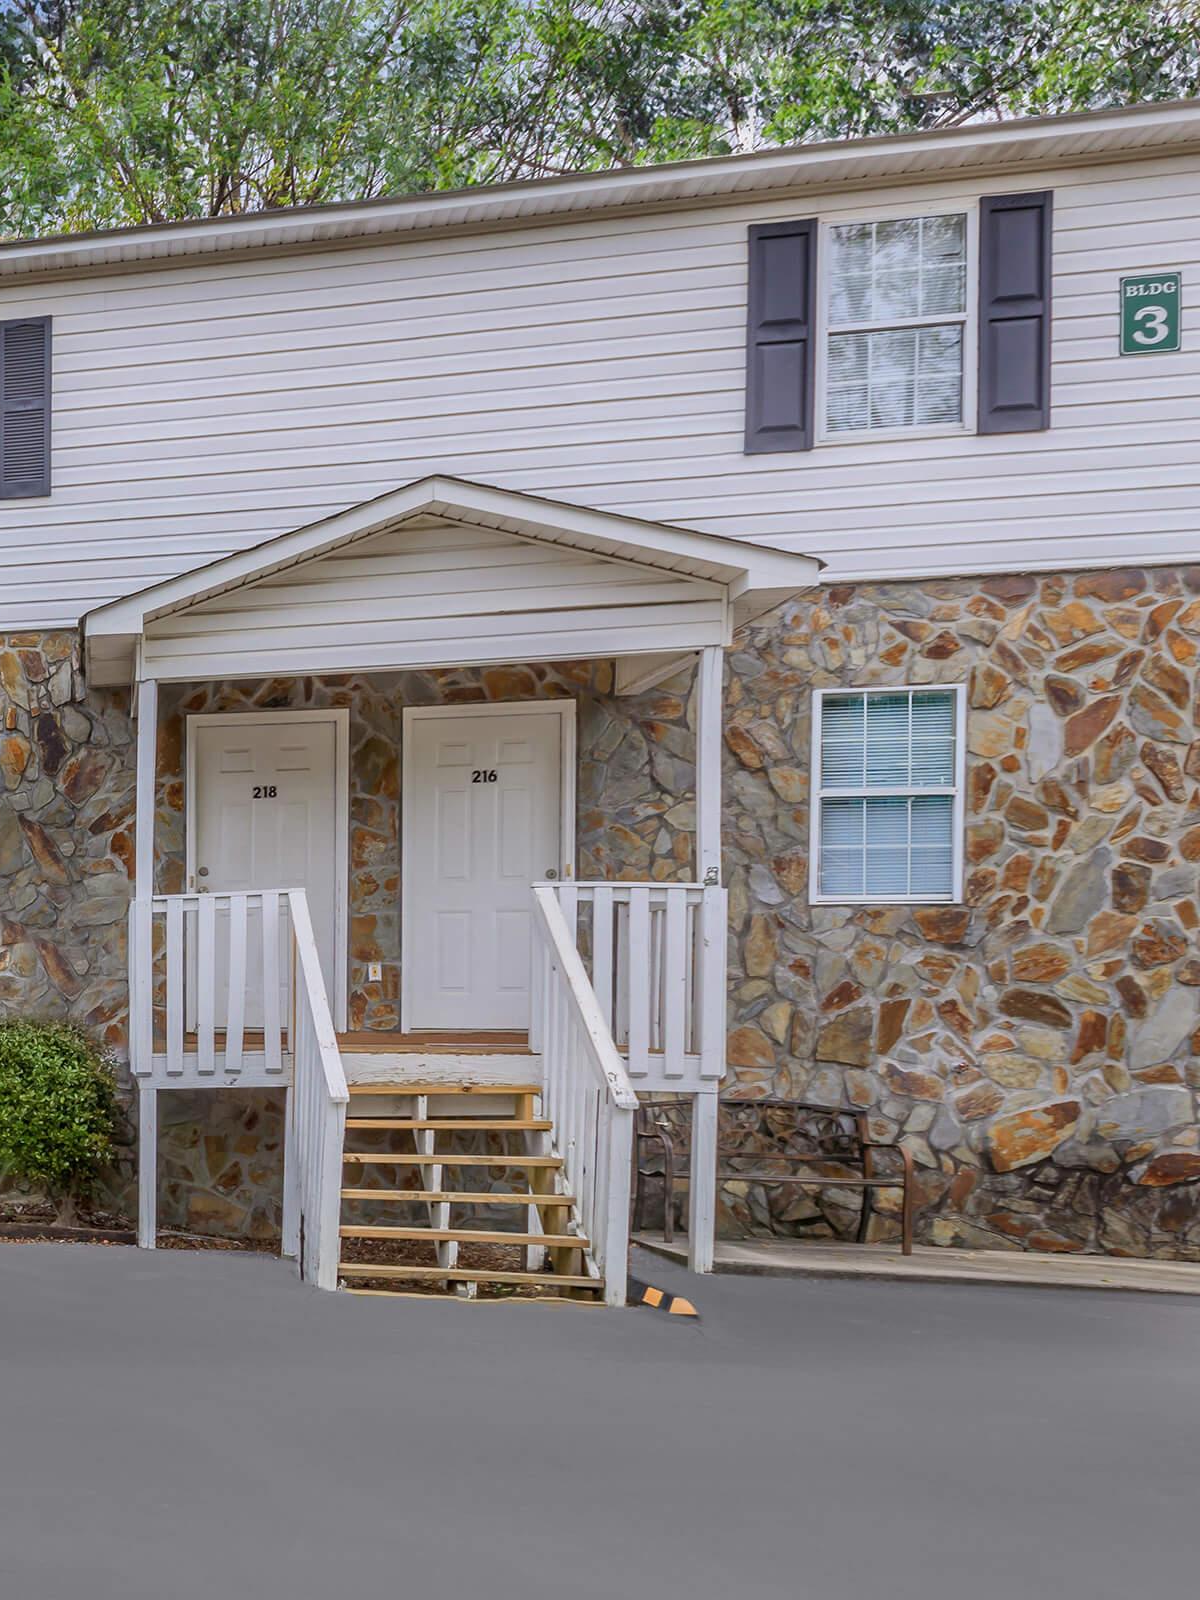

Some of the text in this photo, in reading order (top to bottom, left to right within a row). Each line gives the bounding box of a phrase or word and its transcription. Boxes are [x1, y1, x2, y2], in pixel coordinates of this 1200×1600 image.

[1125, 281, 1177, 297] BLDG
[1132, 305, 1169, 345] 3
[471, 769, 497, 783] 216
[252, 785, 277, 799] 218
